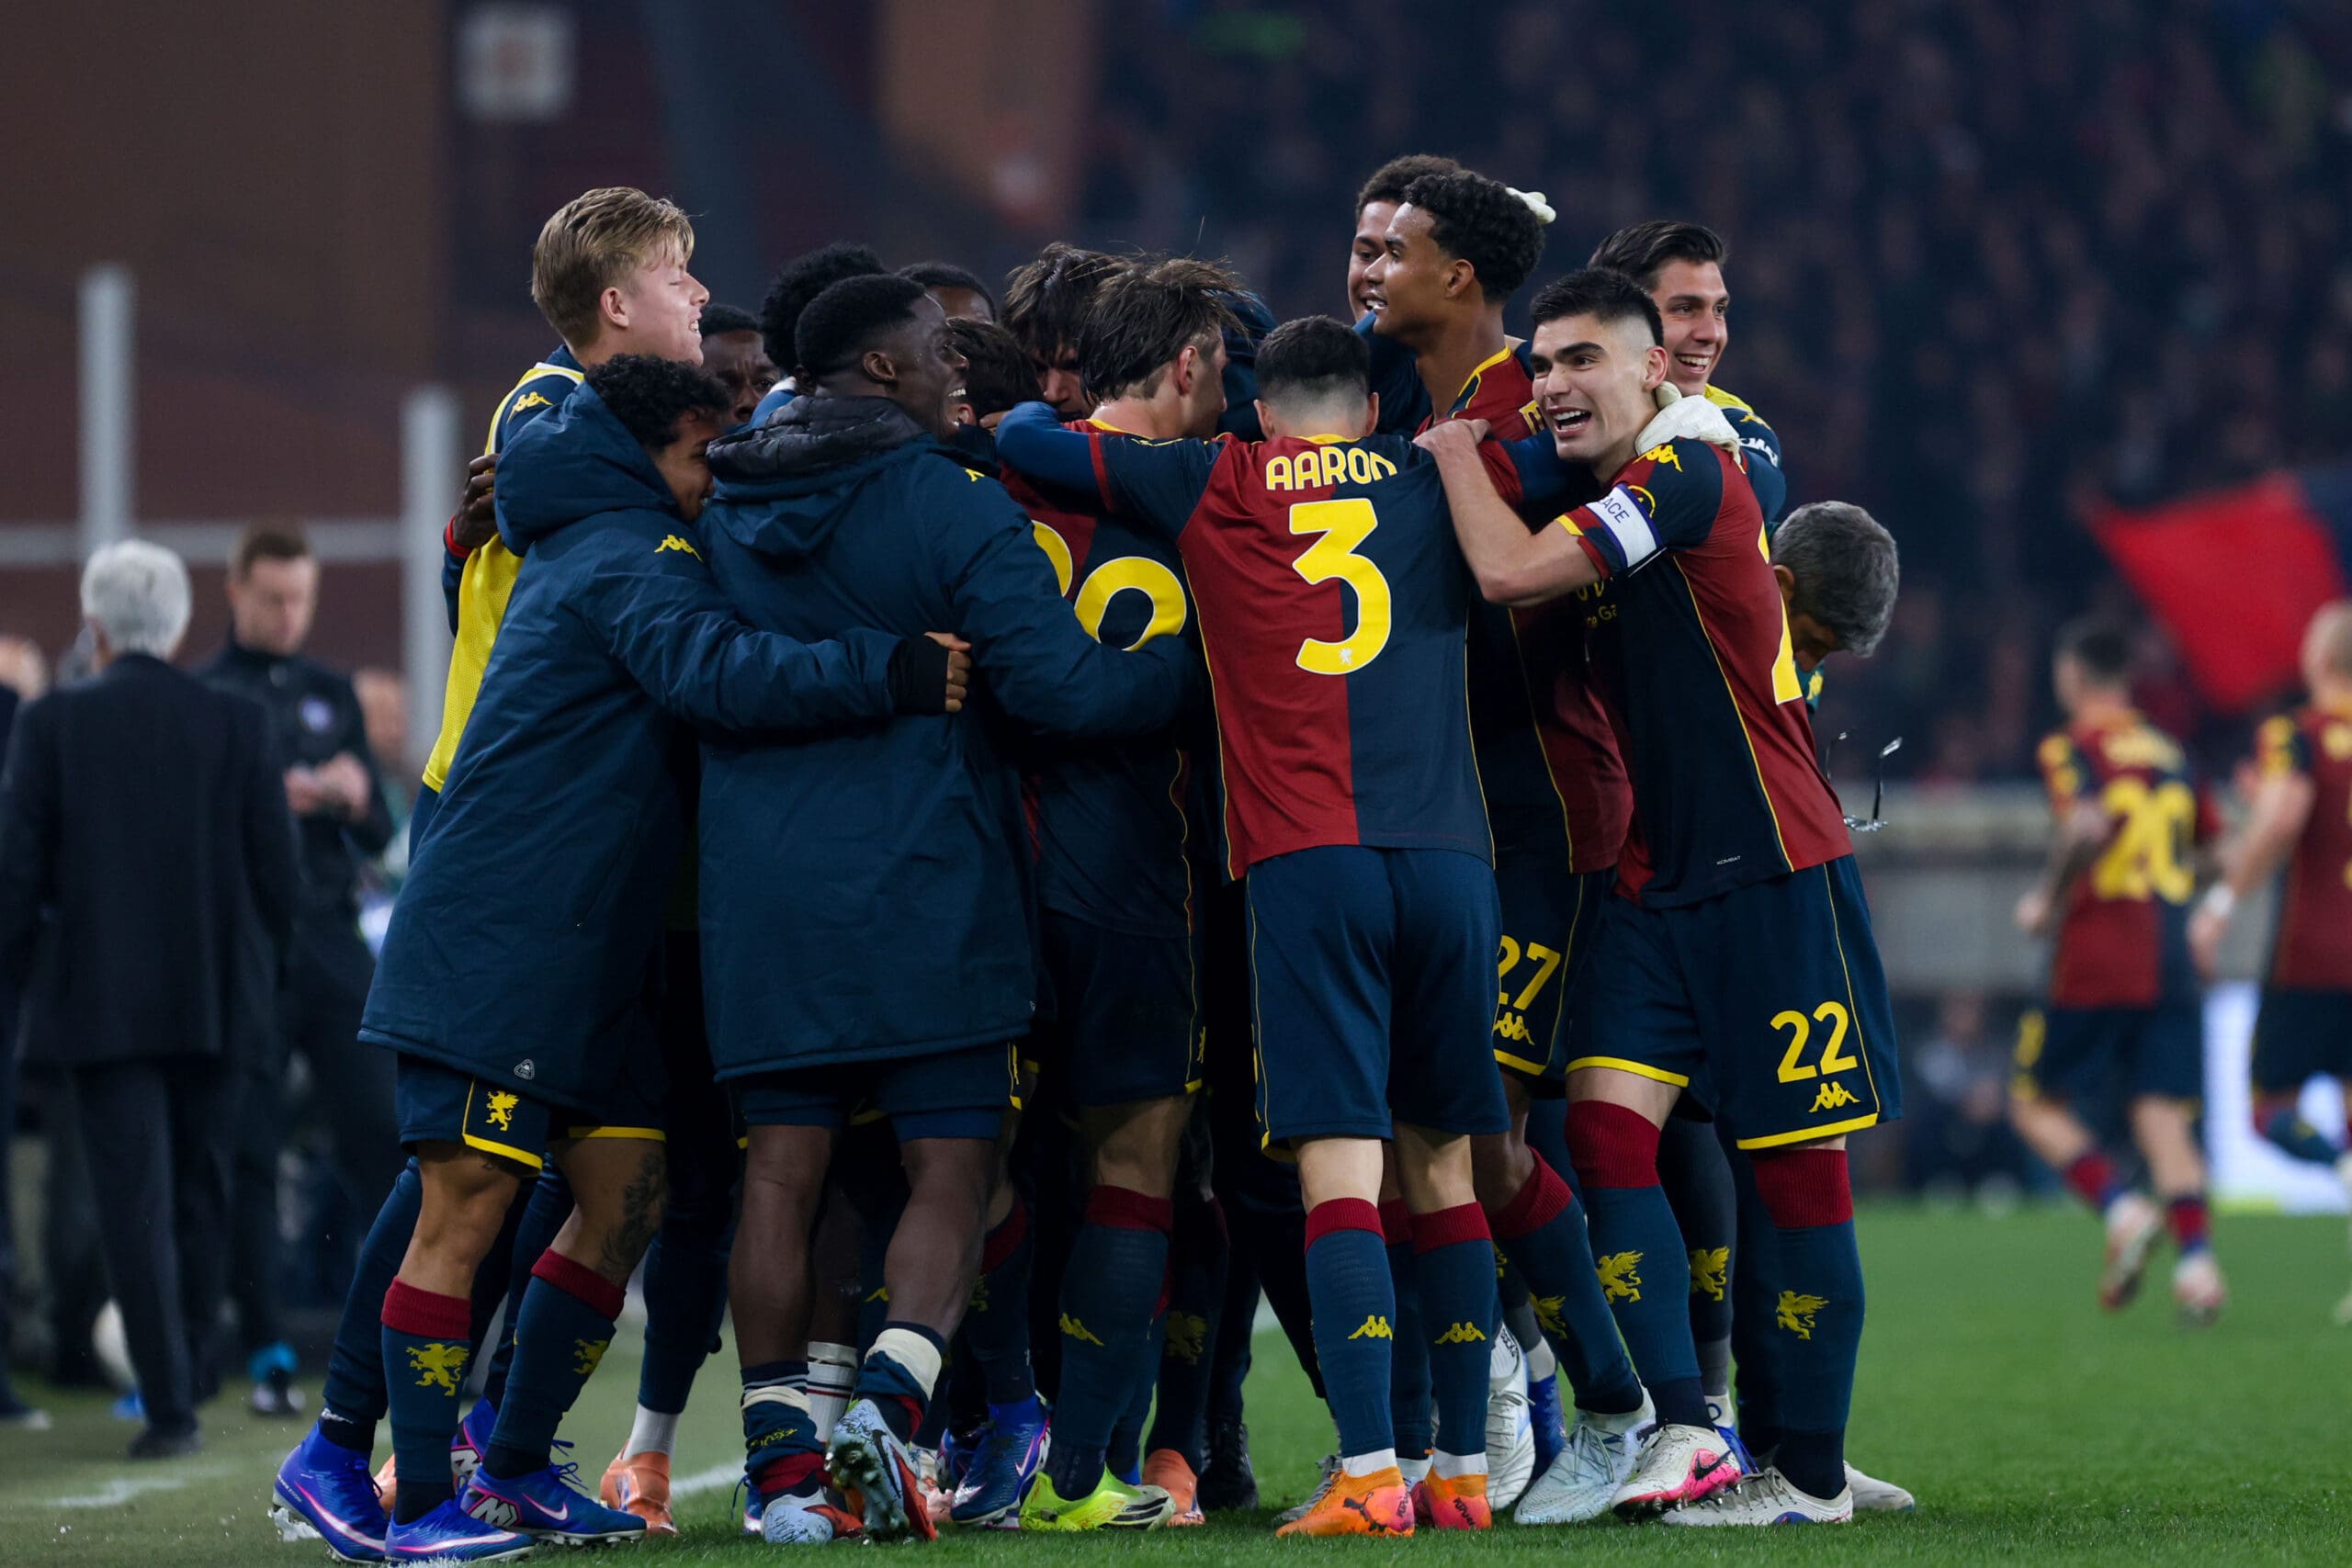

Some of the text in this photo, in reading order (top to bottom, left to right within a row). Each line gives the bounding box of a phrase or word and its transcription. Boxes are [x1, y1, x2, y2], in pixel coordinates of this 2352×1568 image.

[1266, 446, 1397, 491] AARON
[1600, 497, 1630, 524] ACE
[1289, 498, 1391, 675] 3
[2096, 779, 2195, 904] 20
[1498, 934, 1561, 1010] 27
[1770, 1000, 1859, 1084] 22
